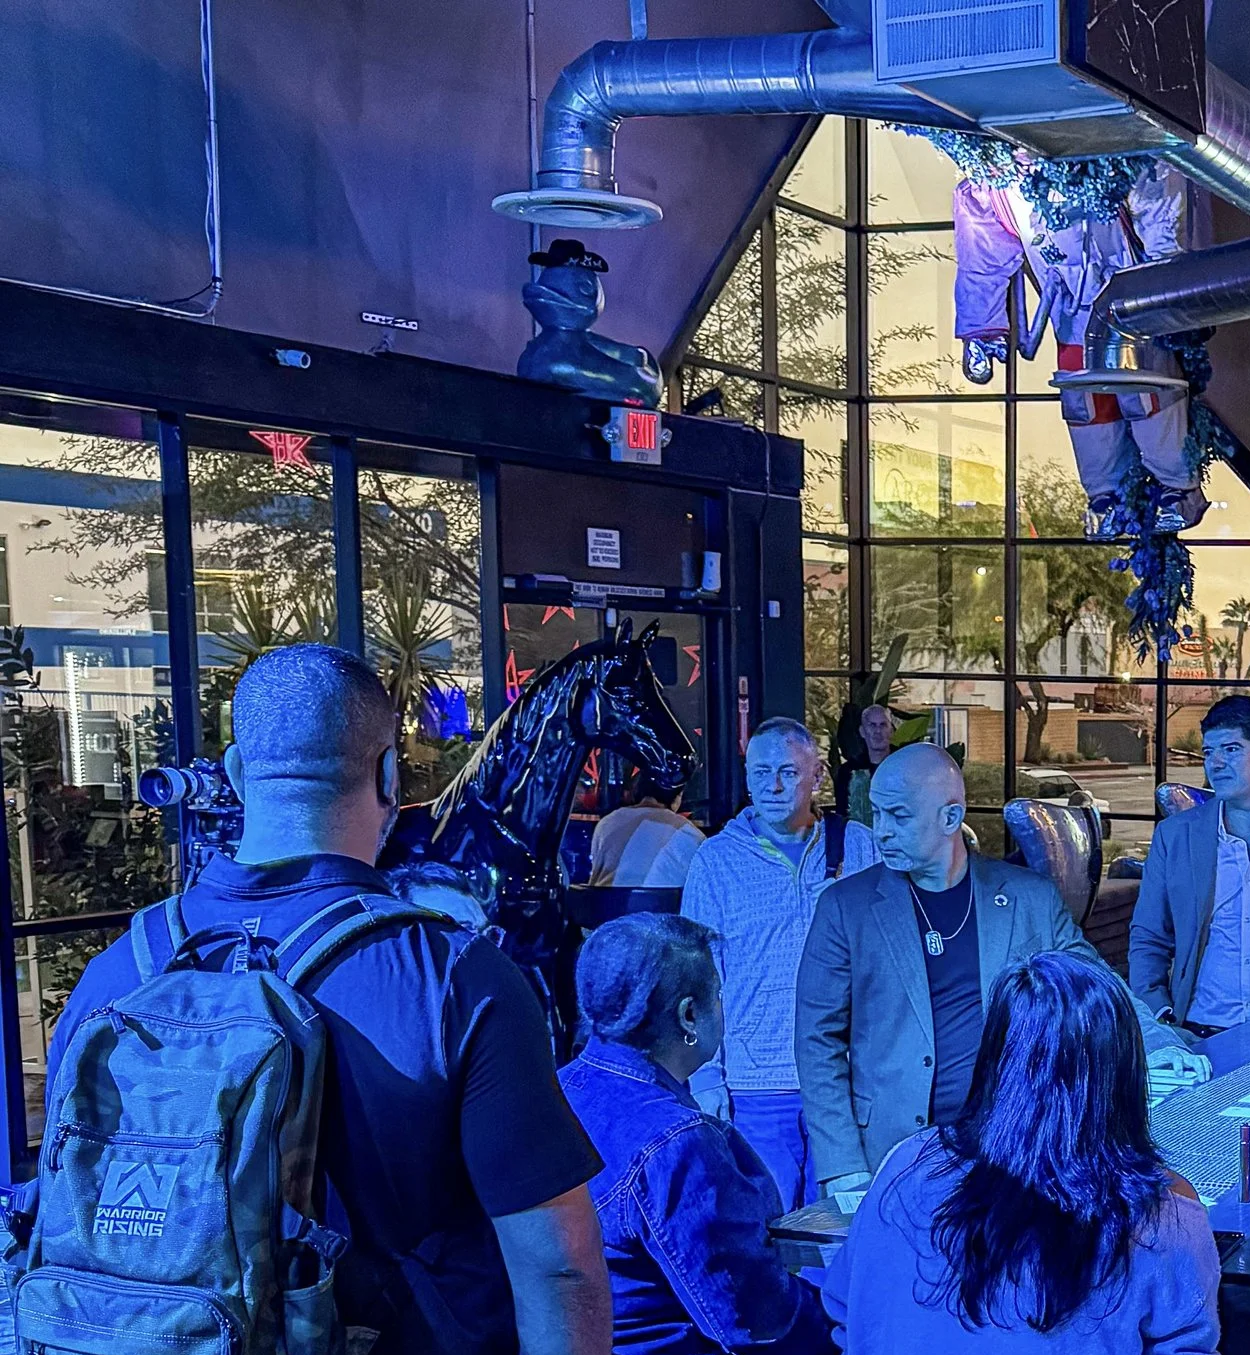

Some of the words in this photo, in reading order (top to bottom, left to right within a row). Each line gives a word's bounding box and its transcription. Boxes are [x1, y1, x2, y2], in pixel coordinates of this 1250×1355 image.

[628, 411, 657, 450] EXIT
[96, 1207, 167, 1222] WARRIOR
[92, 1219, 165, 1237] RISING
